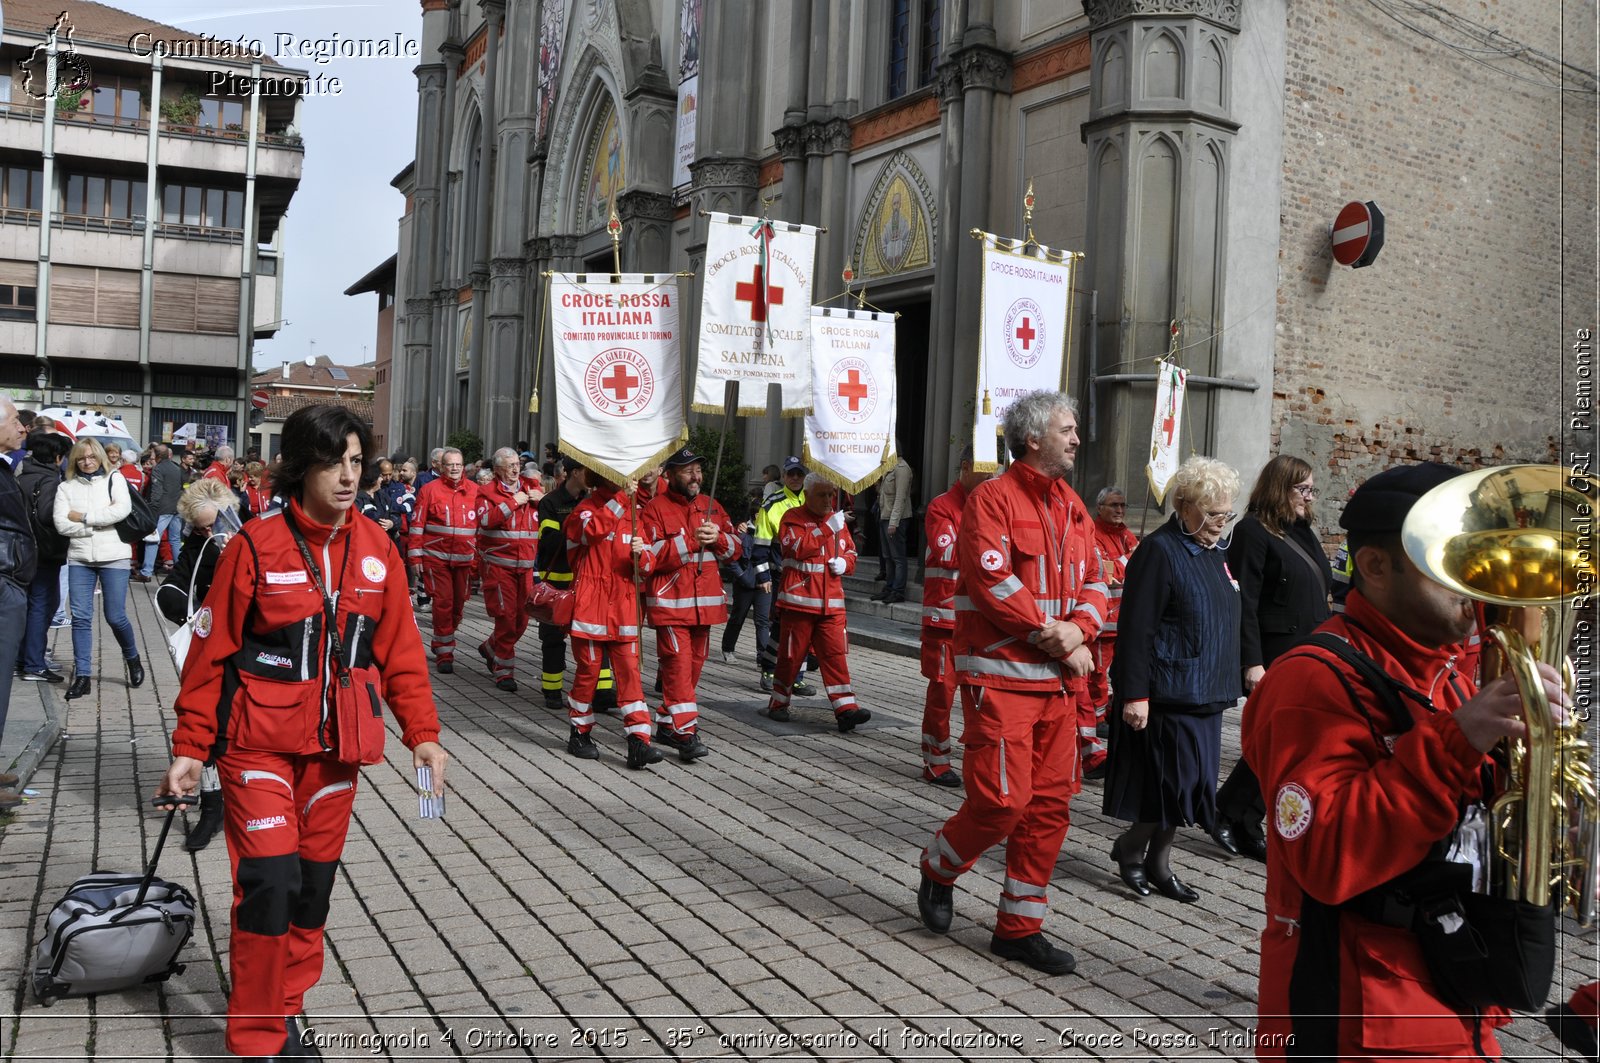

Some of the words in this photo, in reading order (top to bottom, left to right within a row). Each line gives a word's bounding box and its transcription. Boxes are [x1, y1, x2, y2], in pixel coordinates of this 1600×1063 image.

[708, 249, 738, 276] CROCE
[739, 245, 763, 256] ROSS
[771, 249, 807, 288] ITALIANA
[990, 261, 1014, 276] CROCE
[1014, 266, 1036, 280] ROSSA
[1036, 271, 1063, 285] ITALIANA
[561, 293, 613, 308] CROCE
[620, 293, 671, 308] ROSSA
[582, 311, 653, 326] ITALIANA
[563, 332, 596, 341] COMITATO
[597, 331, 640, 341] PROVINCIALE
[642, 331, 649, 340] DI
[650, 331, 672, 340] TORINO
[706, 322, 763, 338] COMITATO
[820, 326, 851, 337] CROCE
[853, 328, 880, 339] ROSSA
[752, 340, 762, 350] DI
[831, 339, 871, 350] ITALIANA
[1005, 313, 1023, 364] CONVENZIONE
[596, 357, 607, 367] DI
[605, 350, 637, 363] GINEVRA
[635, 358, 646, 368] 22
[721, 351, 786, 367] SANTENA
[840, 359, 865, 369] GINEVRA
[713, 368, 732, 376] ANNO
[588, 365, 609, 410] CONVENZIONE
[641, 368, 652, 395] AGOSTO
[160, 397, 229, 411] TEATRO
[633, 394, 648, 409] 1864
[815, 430, 858, 441] COMITATO
[828, 444, 880, 454] NICHELINO
